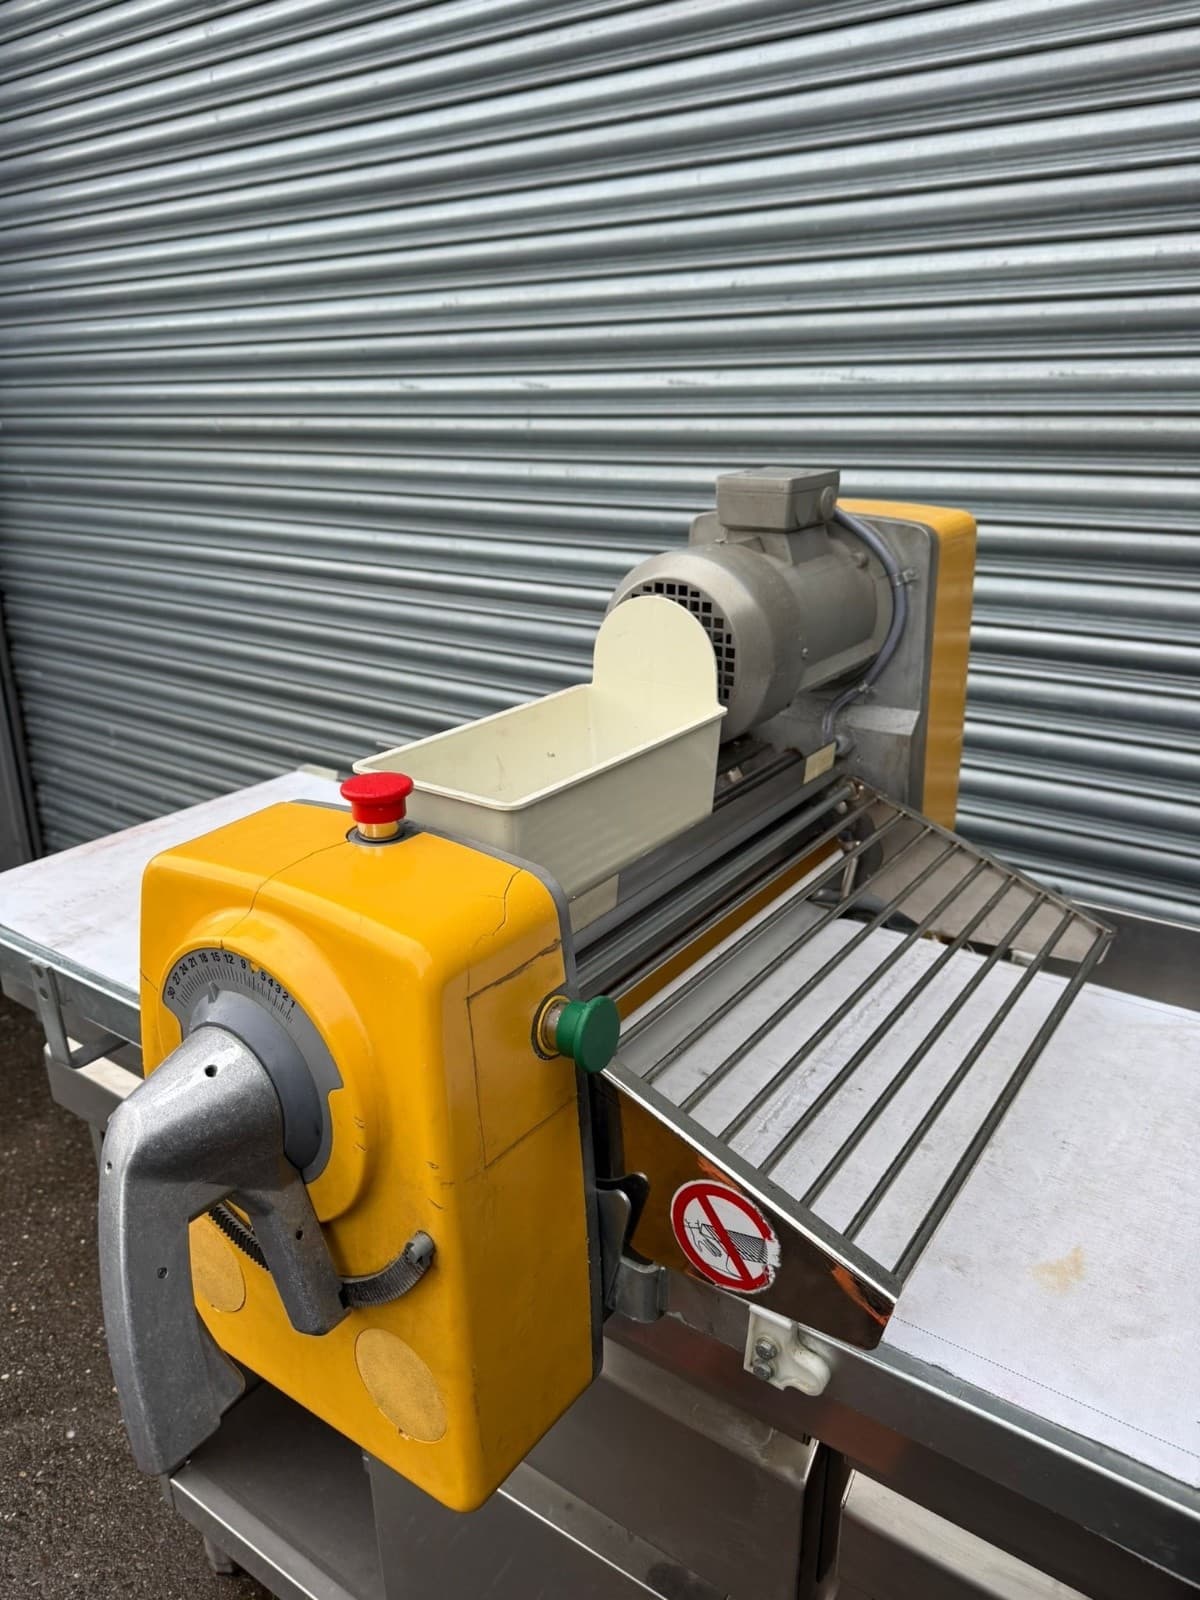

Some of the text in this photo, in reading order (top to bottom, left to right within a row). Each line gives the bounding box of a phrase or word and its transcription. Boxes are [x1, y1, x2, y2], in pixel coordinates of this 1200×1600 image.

[172, 971, 181, 985] 27
[179, 963, 189, 976] 24
[187, 956, 198, 968] 21
[198, 952, 209, 963] 18
[210, 951, 221, 962] 15
[223, 953, 235, 965] 12
[240, 958, 247, 969] 9
[260, 971, 267, 981] 5
[268, 978, 274, 987] 4
[275, 983, 282, 994] 3
[282, 991, 289, 1001] 2
[290, 999, 296, 1008] 1
